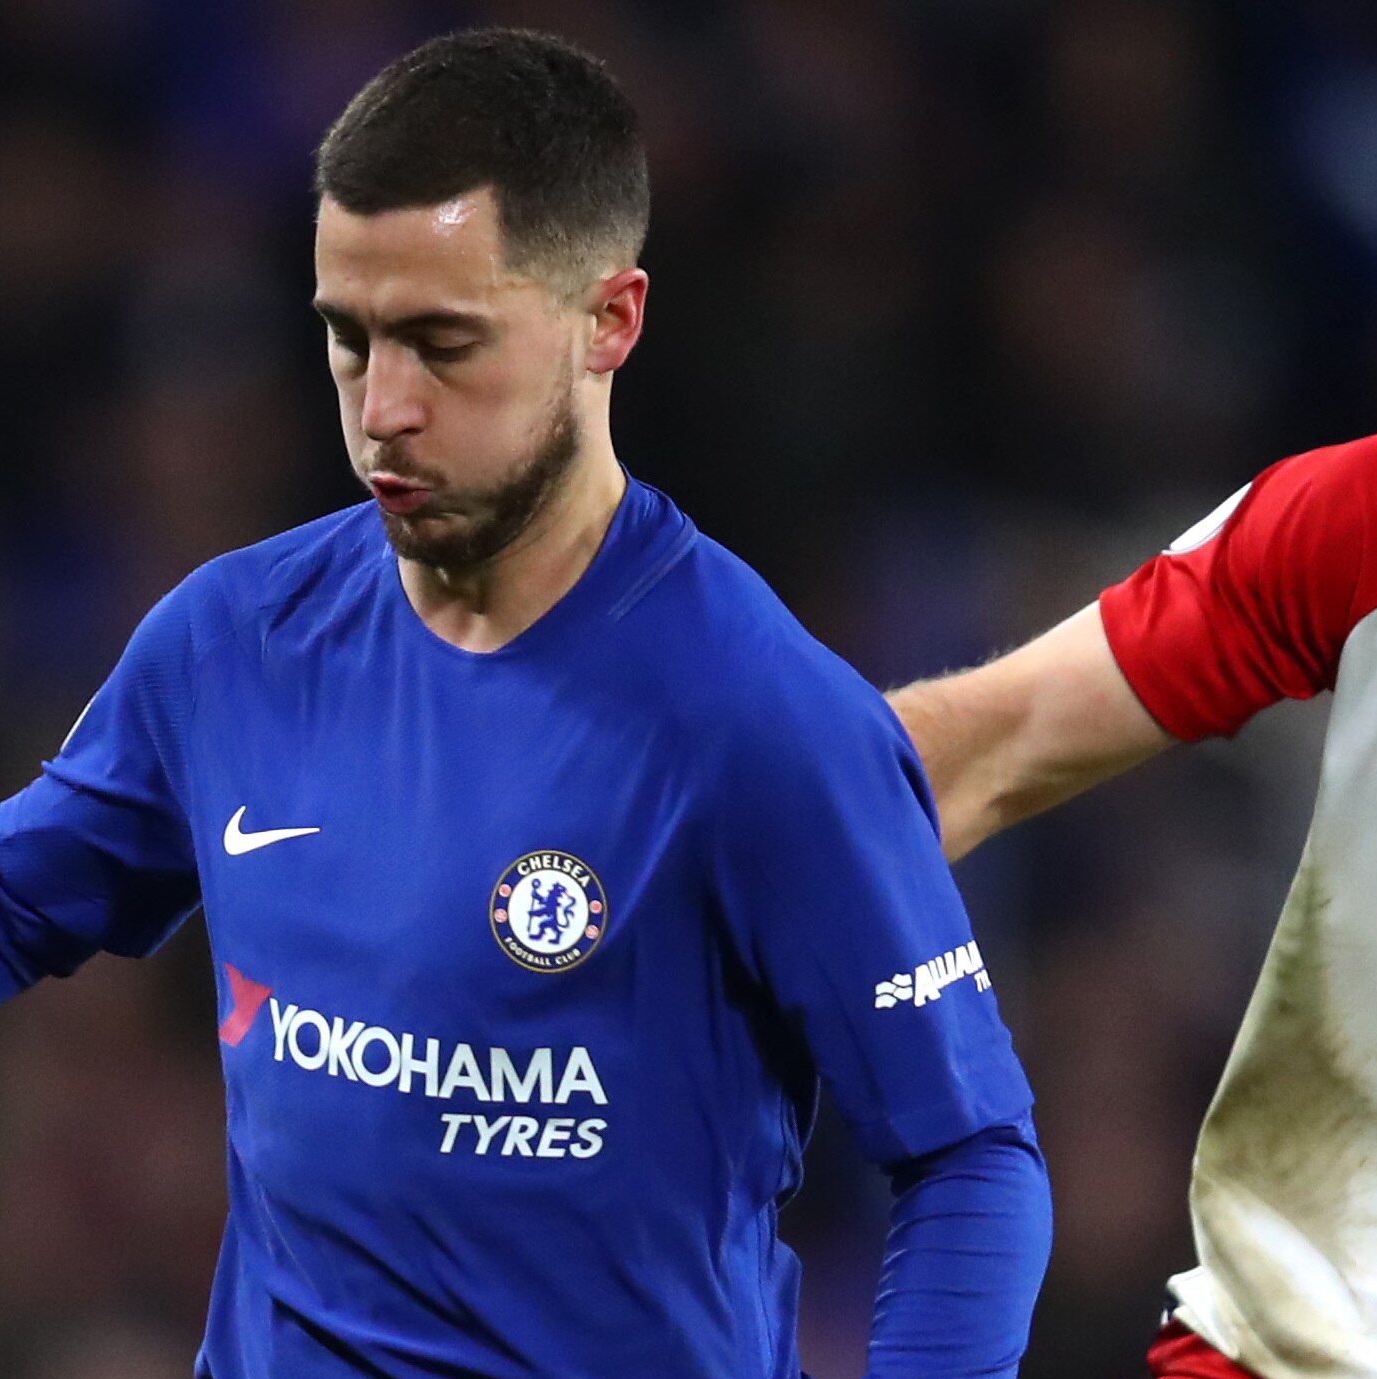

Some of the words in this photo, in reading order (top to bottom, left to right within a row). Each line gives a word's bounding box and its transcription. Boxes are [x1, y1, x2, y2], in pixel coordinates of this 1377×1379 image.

[517, 854, 591, 888] CHELSEA
[504, 936, 552, 967] FOOTBALL
[555, 948, 582, 966] CLUB
[268, 997, 609, 1105] YOKOHAMA
[439, 1112, 608, 1159] TYRES
